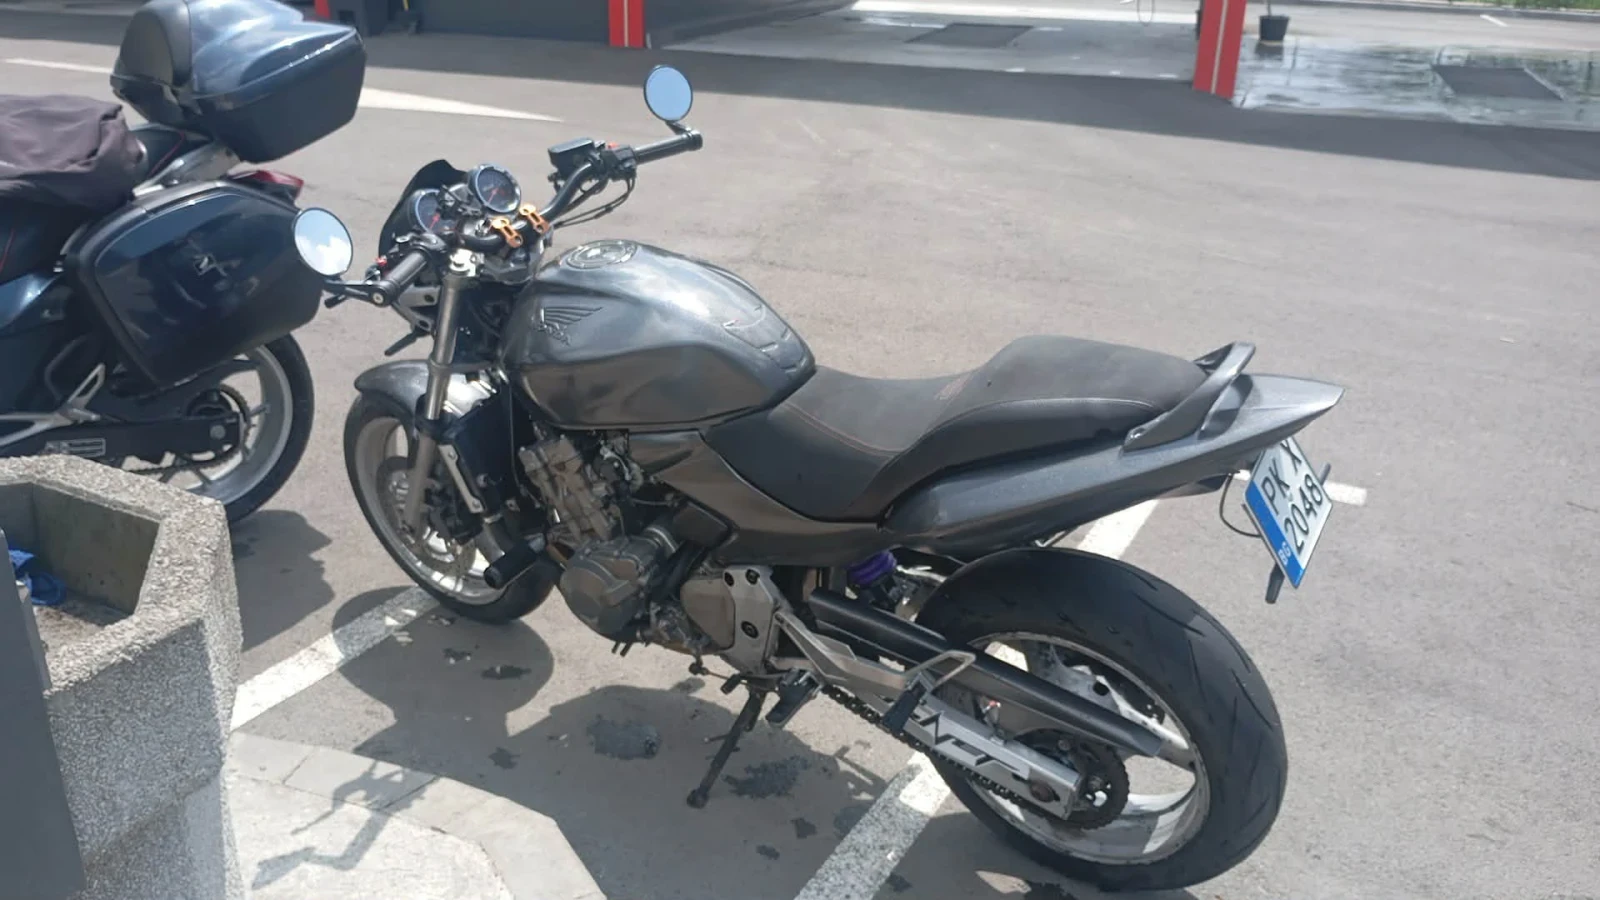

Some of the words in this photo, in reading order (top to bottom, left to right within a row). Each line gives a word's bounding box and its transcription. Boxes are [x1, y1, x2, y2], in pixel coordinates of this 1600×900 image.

[1261, 458, 1290, 515] PK
[1280, 438, 1302, 473] X
[1284, 474, 1323, 554] 2048
[1278, 541, 1291, 565] BG
